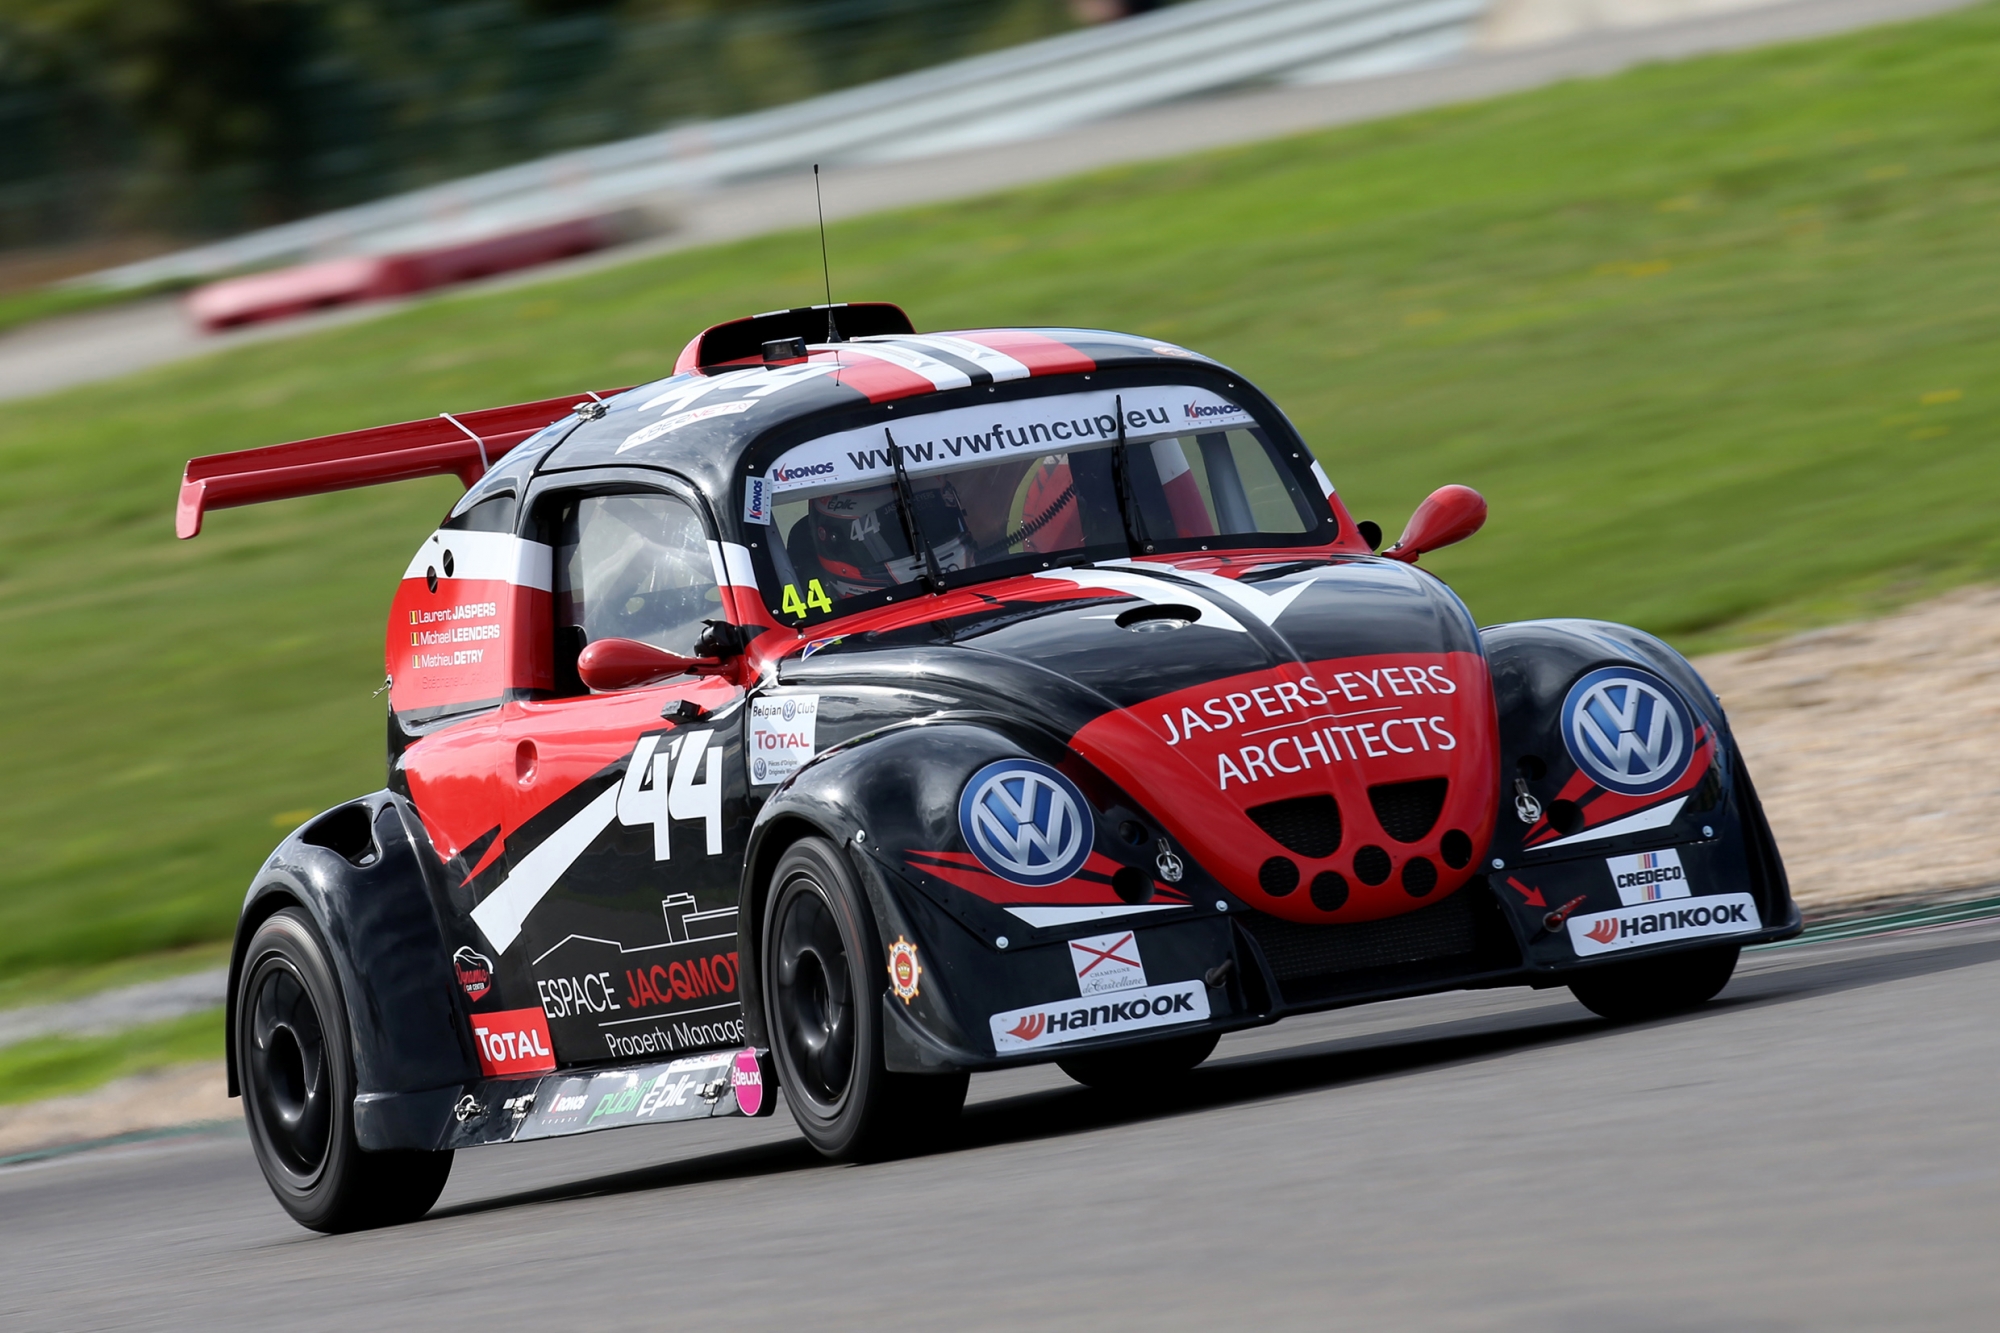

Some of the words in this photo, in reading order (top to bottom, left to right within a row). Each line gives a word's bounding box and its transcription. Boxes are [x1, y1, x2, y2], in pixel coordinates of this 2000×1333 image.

[1183, 400, 1242, 419] KRONOS
[772, 462, 835, 482] KRONOS
[747, 479, 763, 520] KRONOS
[850, 510, 881, 541] 44
[781, 578, 834, 619] 44
[418, 608, 452, 624] Laurent
[452, 602, 496, 620] JASPERS
[420, 629, 452, 645] Michael
[451, 624, 500, 642] LEENDERS
[421, 653, 454, 668] Mathieu
[453, 649, 484, 665] DETRY
[752, 705, 782, 719] Belgian
[797, 702, 816, 714] Club
[1161, 665, 1457, 746] JASPERS-EYERS
[754, 730, 810, 750] TOTAL
[1218, 716, 1457, 790] ARCHITECTS
[617, 729, 723, 861] 44
[1617, 866, 1682, 889] CREDECO
[1089, 967, 1131, 978] CHAMPAGNE
[537, 972, 621, 1019] ESPACE
[474, 1027, 550, 1062] TOTAL
[604, 1026, 674, 1057] Property
[672, 1018, 744, 1049] Manage
[547, 1089, 589, 1114] KRONOS
